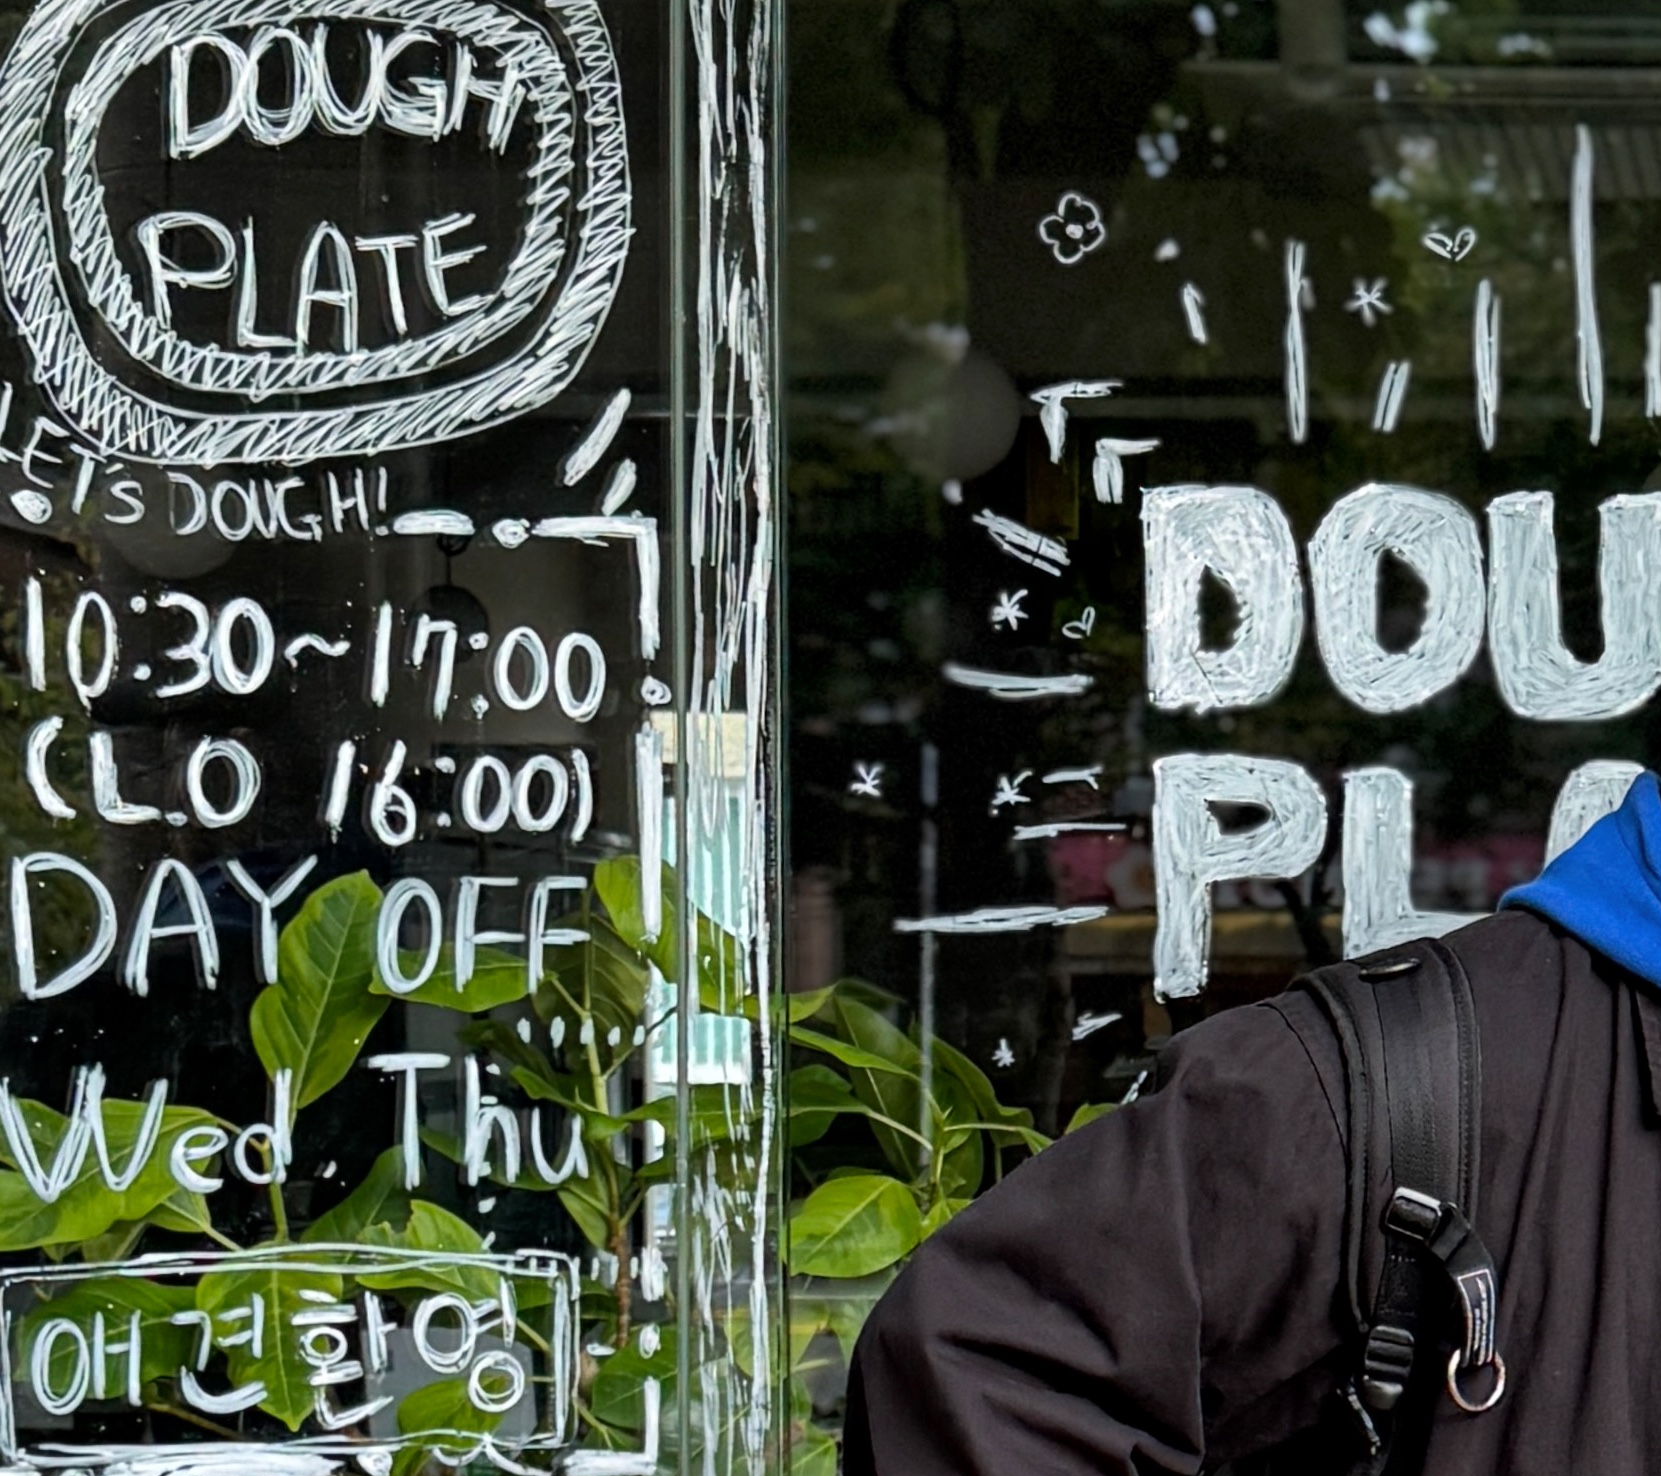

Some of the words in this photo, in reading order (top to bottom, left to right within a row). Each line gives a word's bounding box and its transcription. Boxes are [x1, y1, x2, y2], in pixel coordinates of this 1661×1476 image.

[169, 22, 526, 158] DOUGH
[137, 210, 486, 354] PLATE
[166, 467, 390, 541] DOUGH!
[12, 852, 318, 1001] DAY
[376, 875, 588, 994] OFF
[363, 1053, 590, 1192] Thu
[30, 1288, 525, 1432] 애견환영
